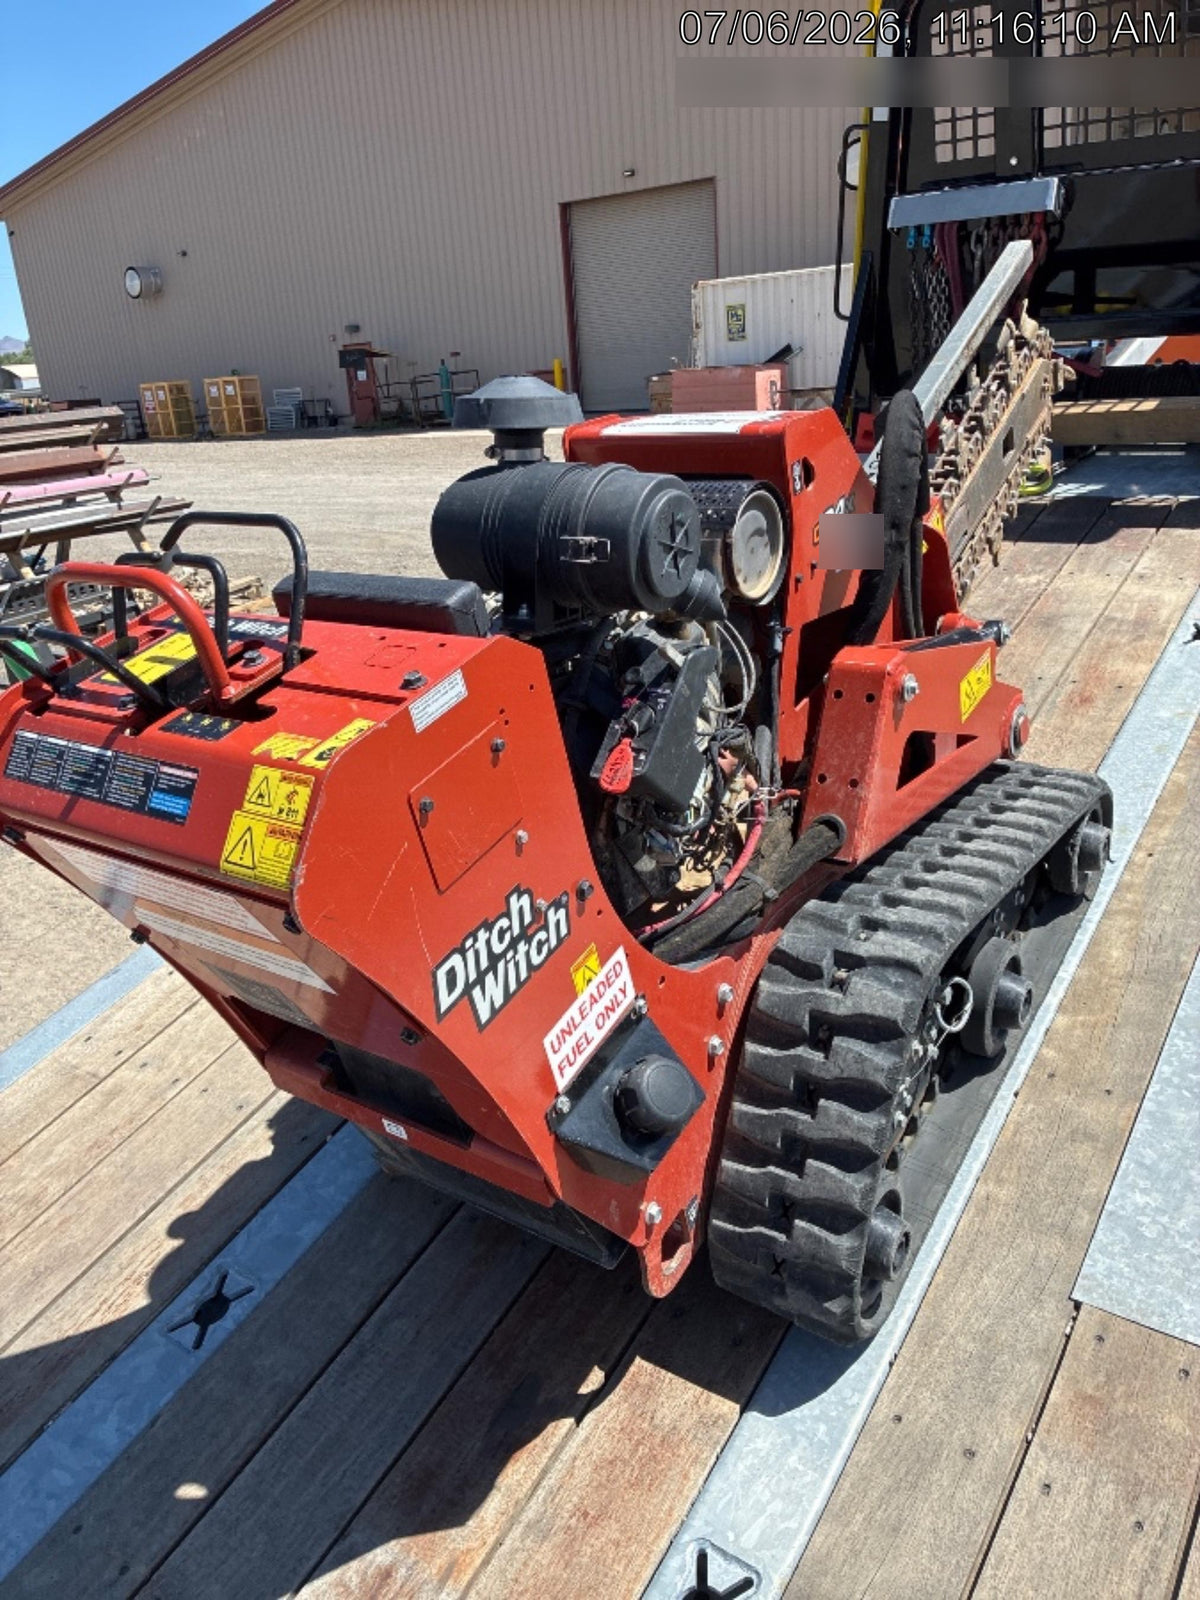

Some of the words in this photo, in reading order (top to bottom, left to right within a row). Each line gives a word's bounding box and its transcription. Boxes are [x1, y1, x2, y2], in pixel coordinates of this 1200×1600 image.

[436, 891, 533, 1015] Ditch
[471, 905, 568, 1026] Witch
[549, 960, 623, 1055] UNLEADED
[557, 1032, 595, 1080] FUEL
[595, 981, 628, 1031] ONLY
